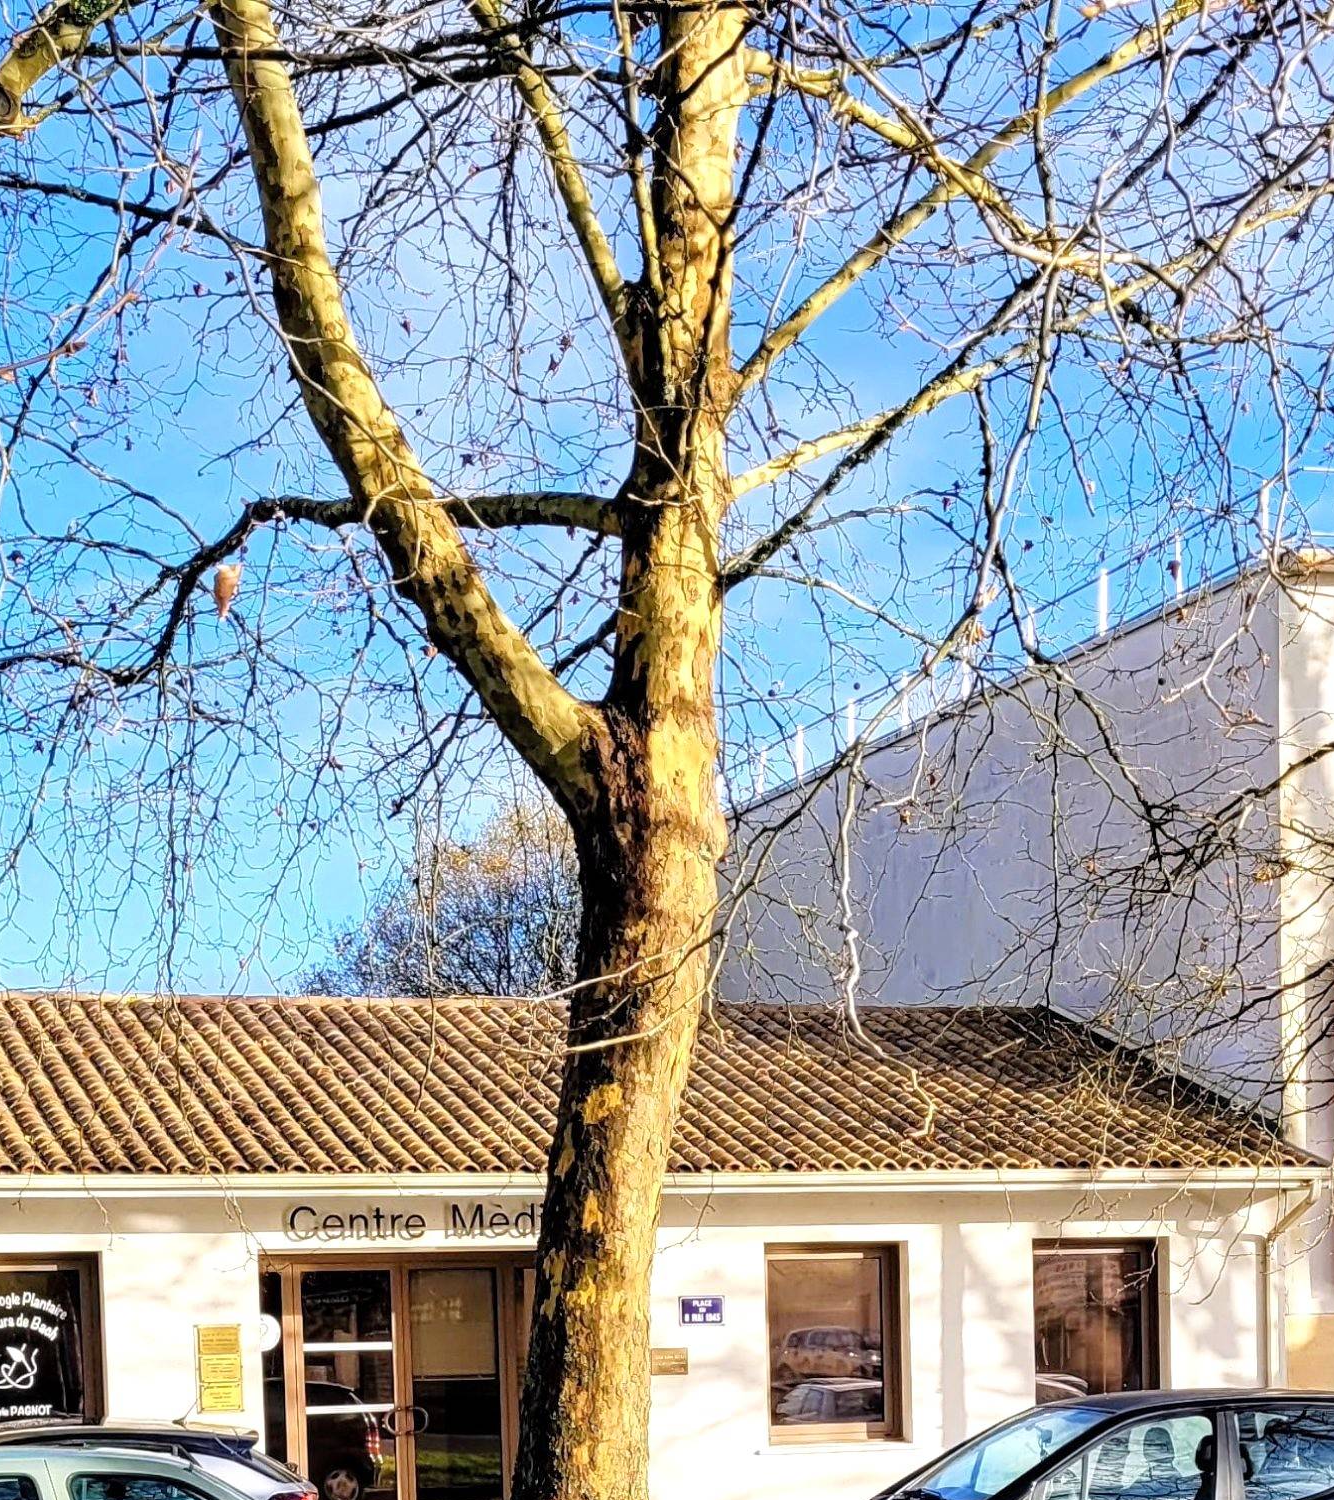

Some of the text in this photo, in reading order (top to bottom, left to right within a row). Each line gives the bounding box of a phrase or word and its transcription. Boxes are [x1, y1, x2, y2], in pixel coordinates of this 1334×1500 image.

[289, 1205, 427, 1239] Centre
[22, 1291, 68, 1320] Plantaire
[692, 1299, 713, 1307] PLACE
[16, 1313, 30, 1328] de
[30, 1315, 59, 1341] Bach
[691, 1313, 704, 1322] MAI
[9, 1404, 53, 1416] PAGNOT
